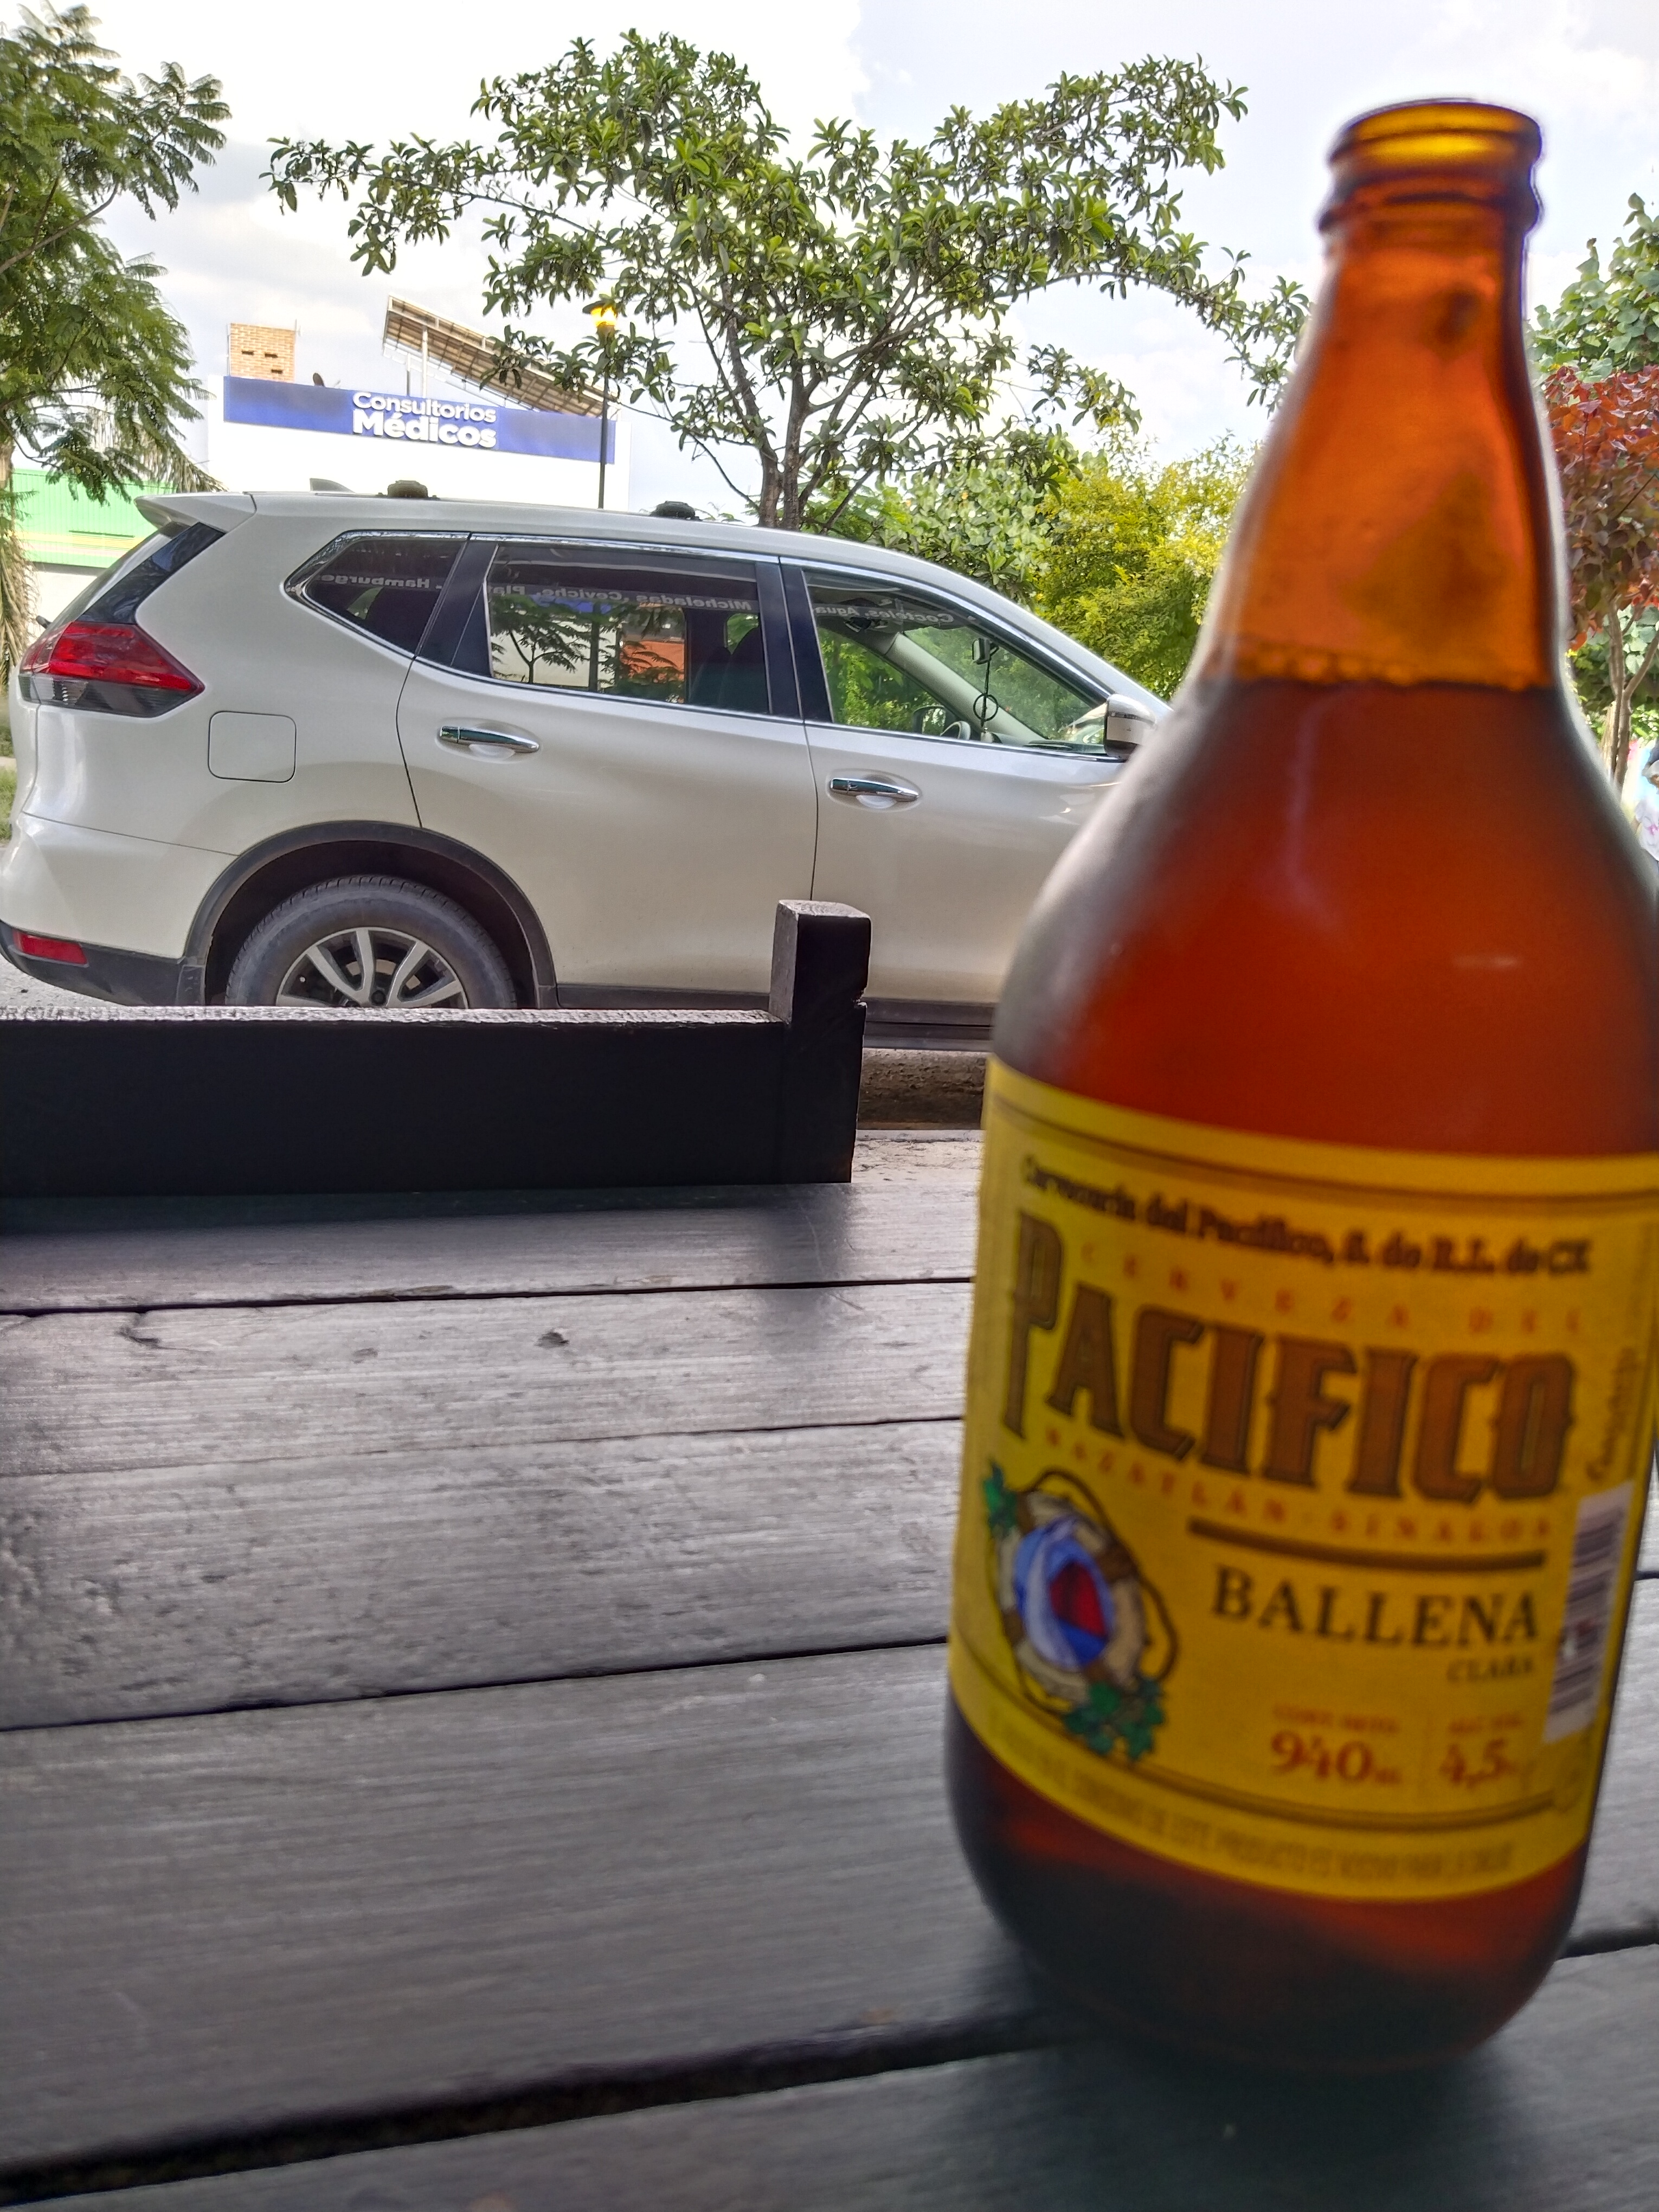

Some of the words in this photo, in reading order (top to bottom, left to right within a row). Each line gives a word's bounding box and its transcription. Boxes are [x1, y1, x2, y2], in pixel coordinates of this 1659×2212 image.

[353, 391, 497, 425] Consultorios
[352, 409, 497, 449] Médicos
[1212, 1564, 1540, 1650] BALLENA
